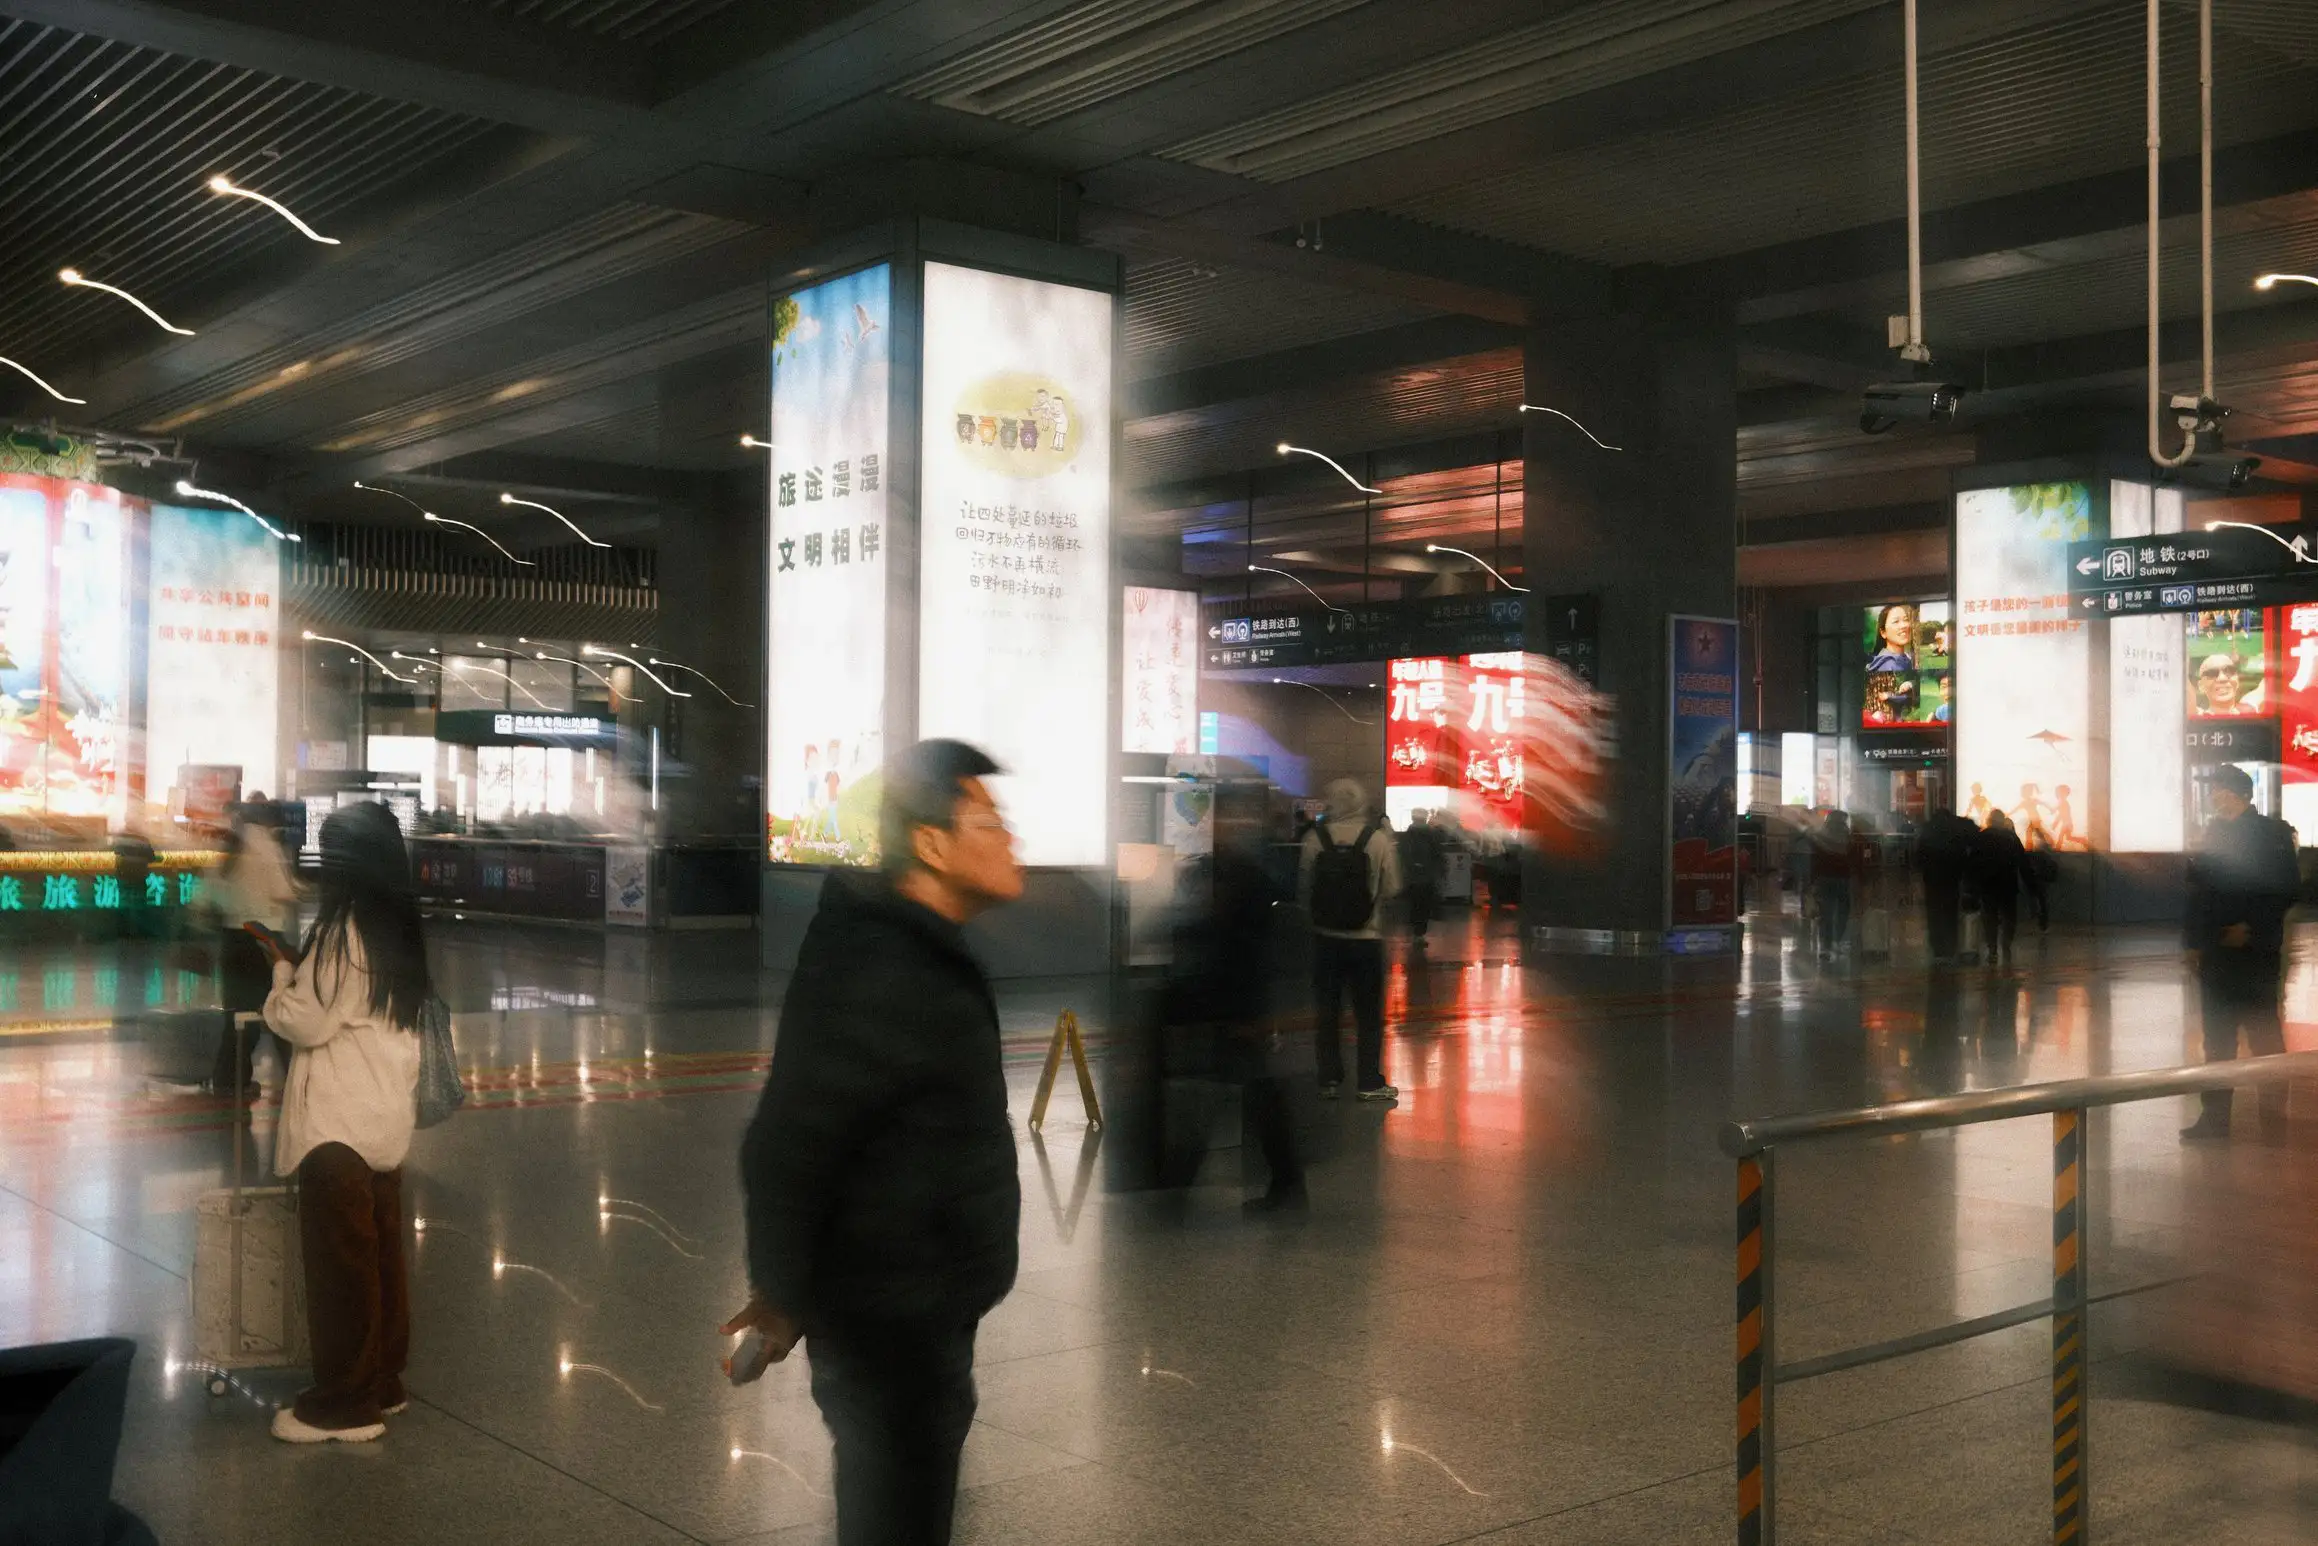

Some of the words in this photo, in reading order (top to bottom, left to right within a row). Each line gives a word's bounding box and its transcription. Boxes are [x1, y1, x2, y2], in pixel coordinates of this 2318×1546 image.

[777, 522, 880, 573] 文明相伴
[2139, 565, 2177, 577] Subway
